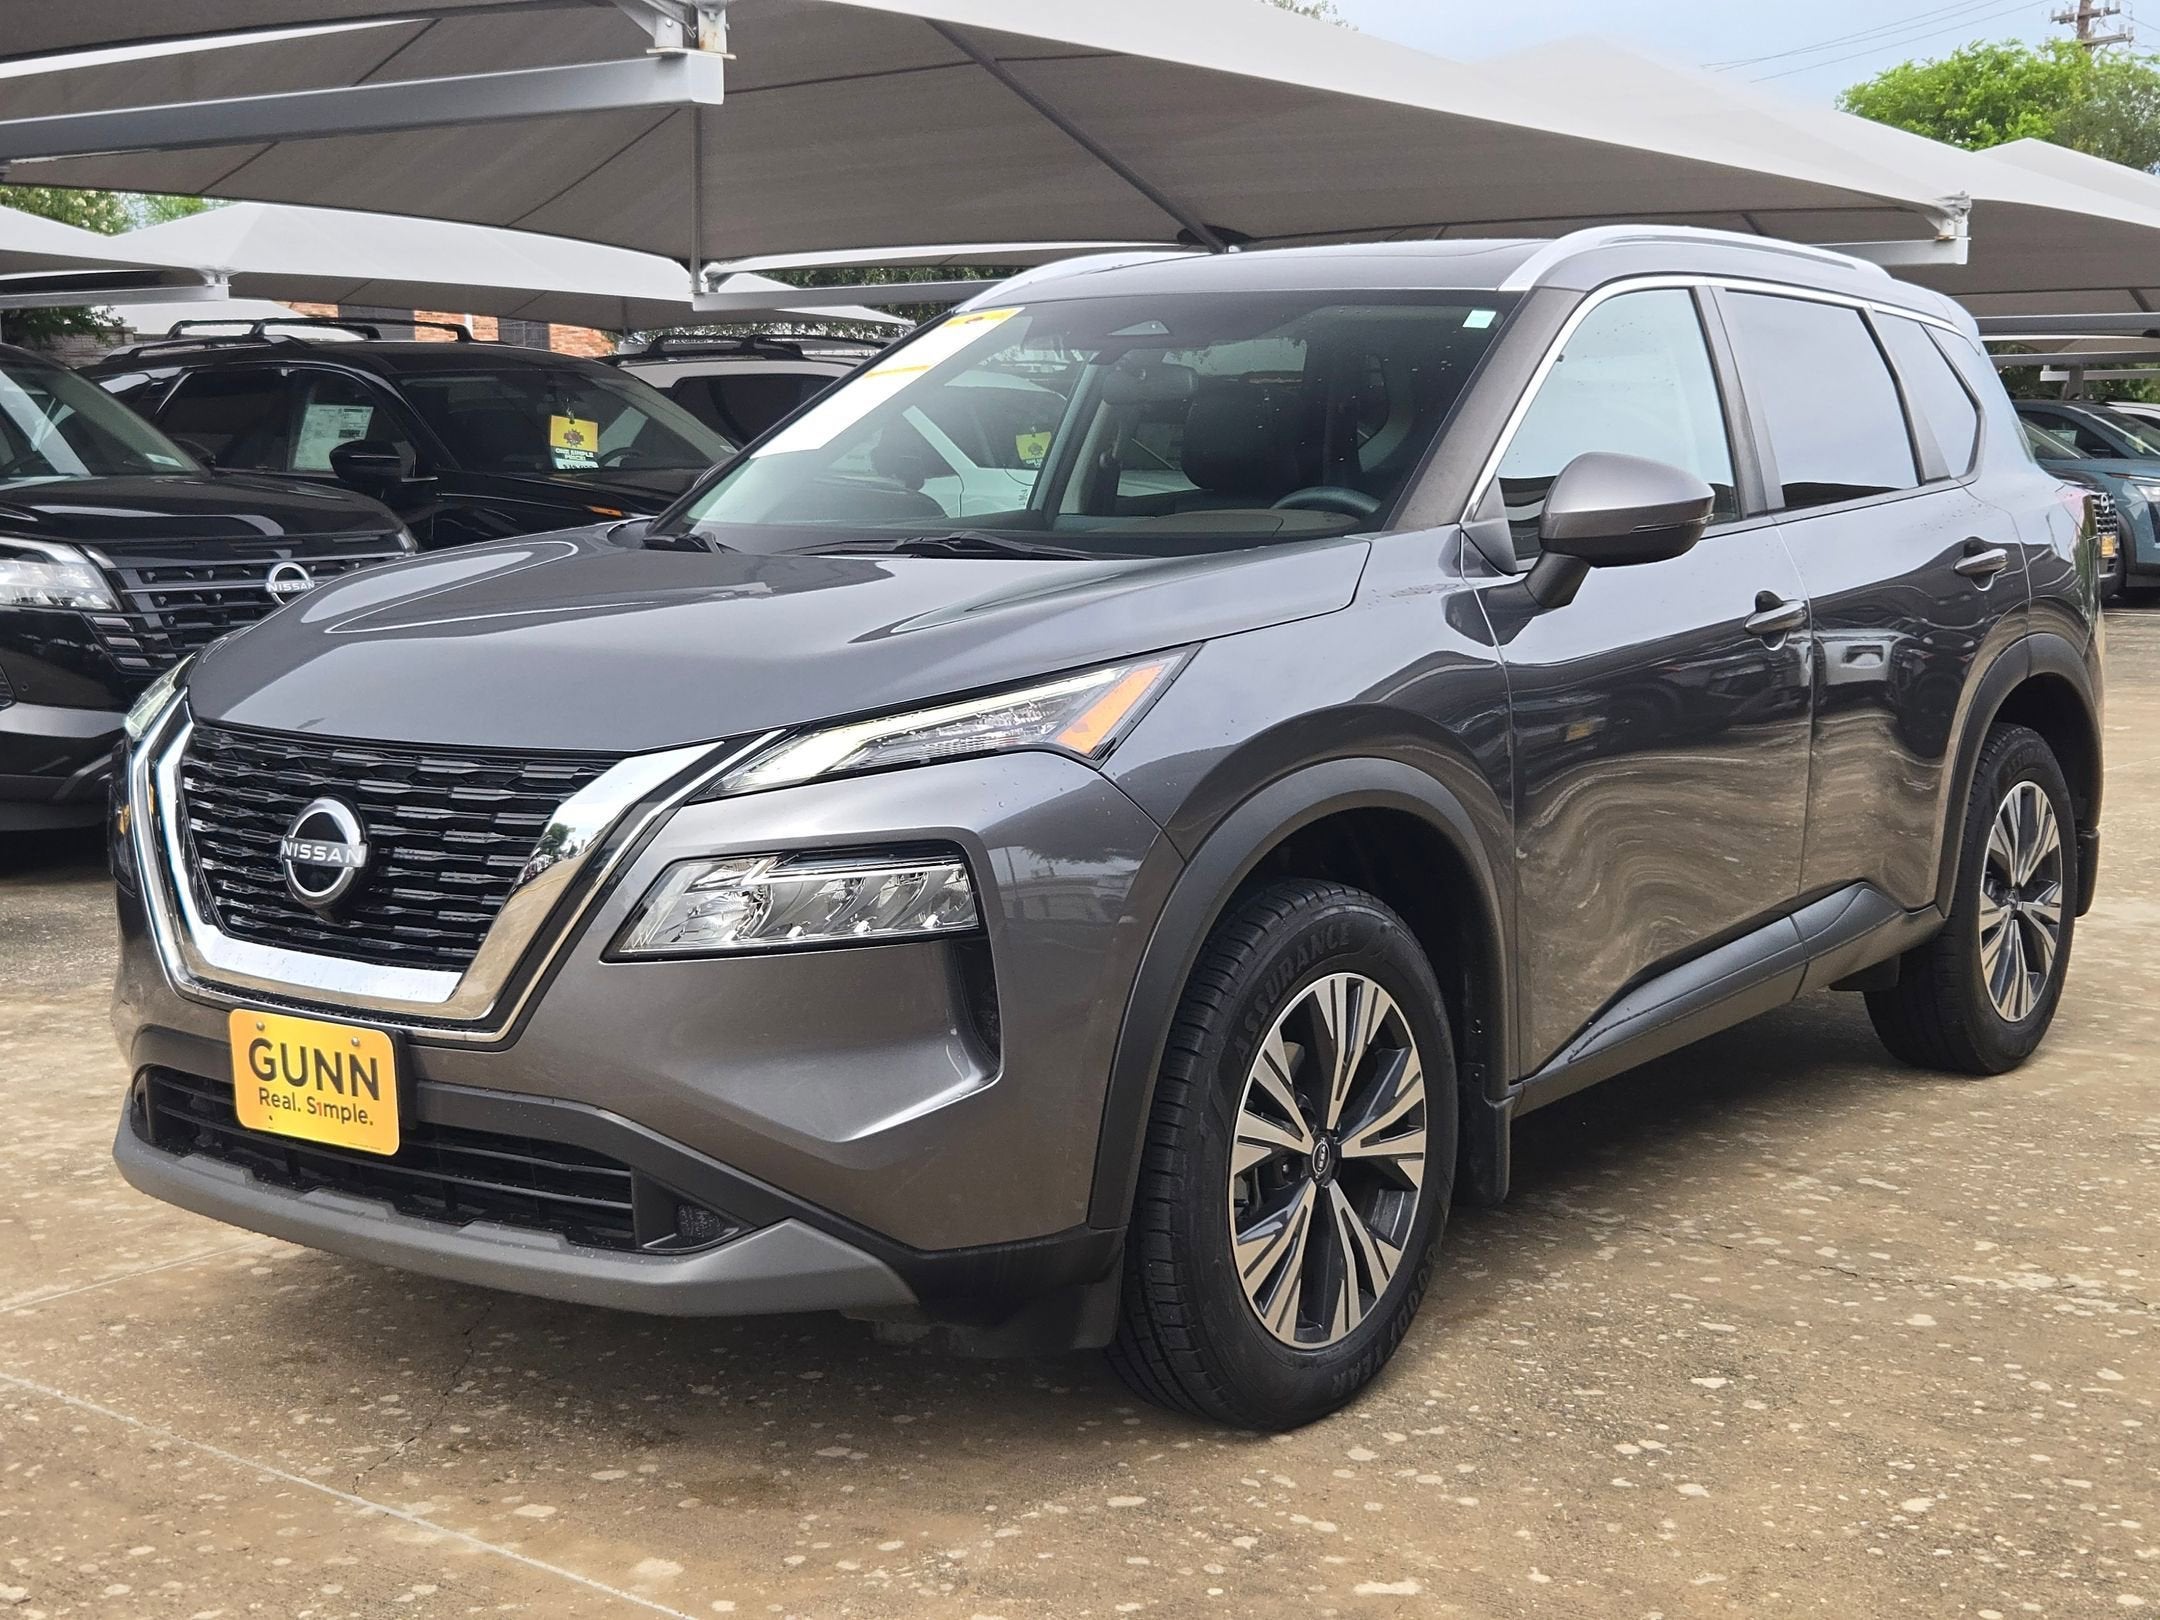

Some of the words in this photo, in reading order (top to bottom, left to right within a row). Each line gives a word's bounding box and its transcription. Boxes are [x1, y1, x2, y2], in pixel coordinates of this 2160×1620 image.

[265, 580, 315, 592] NISSAN
[282, 840, 363, 864] NISSAN
[1234, 920, 1352, 1067] ASSURANCE
[249, 1037, 380, 1101] GUNN
[258, 1087, 302, 1112] Real.
